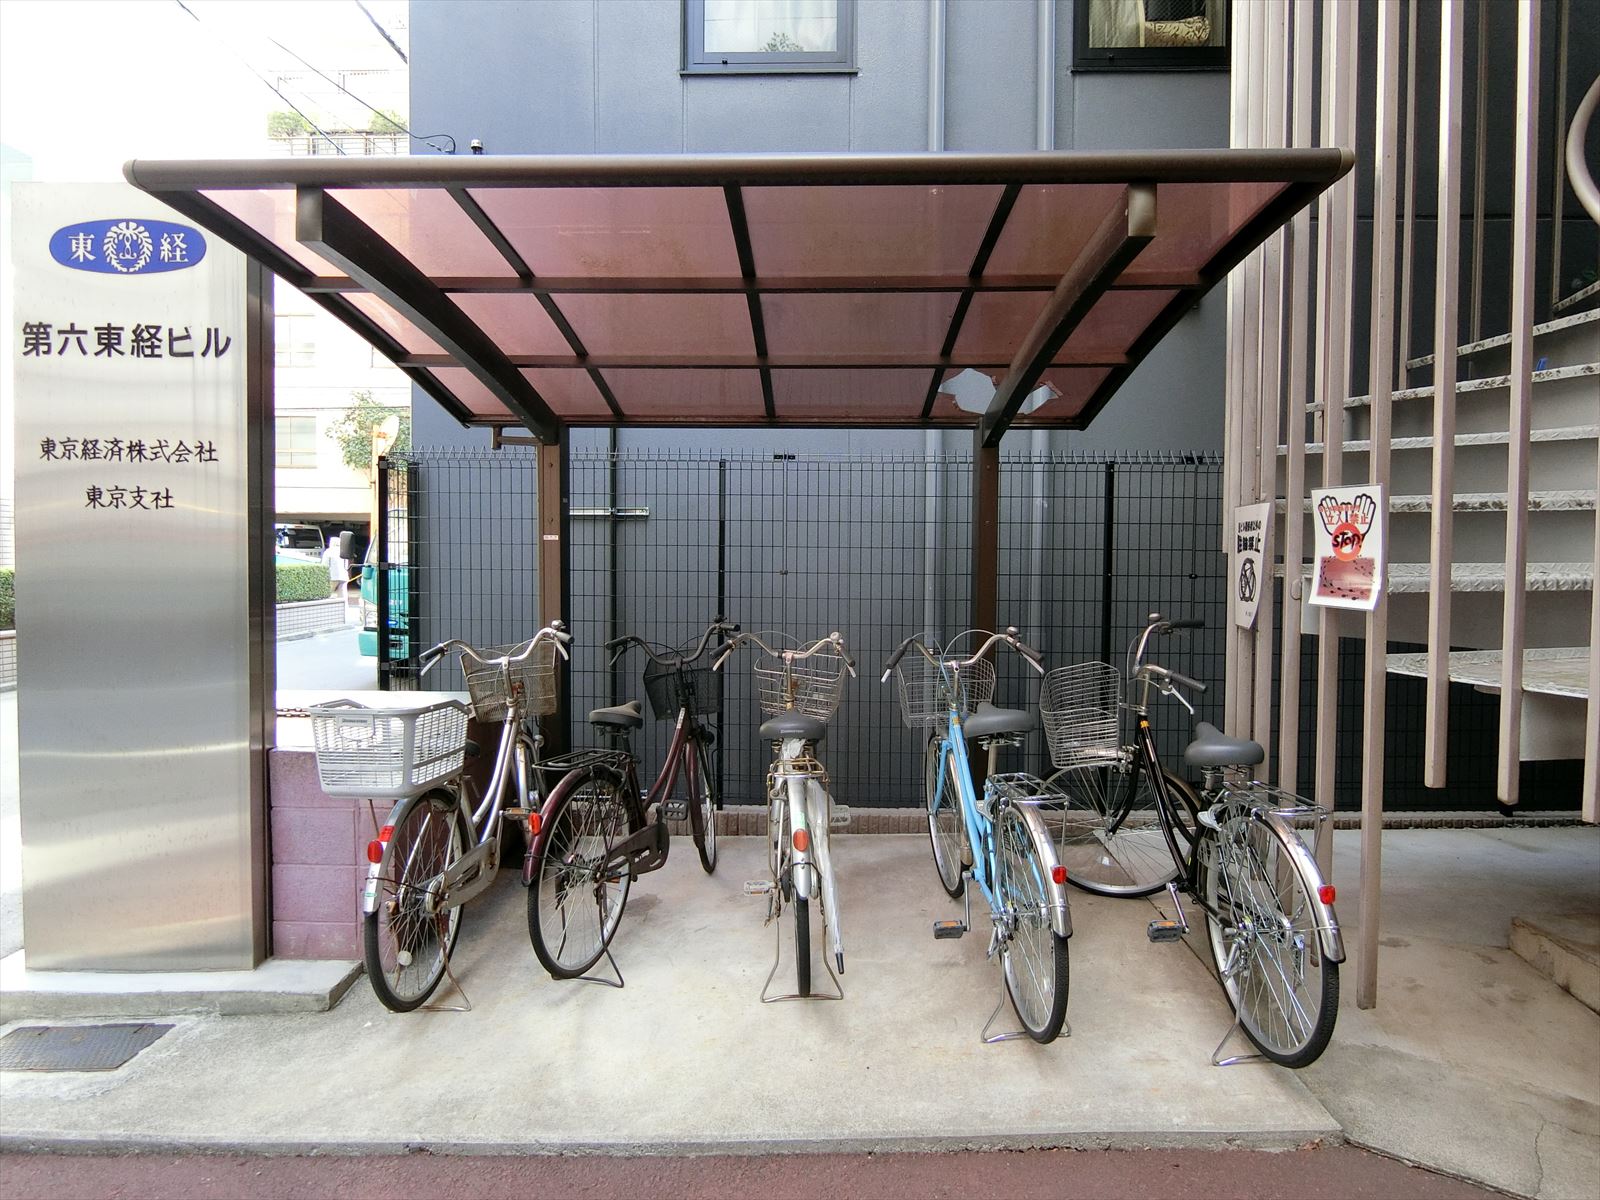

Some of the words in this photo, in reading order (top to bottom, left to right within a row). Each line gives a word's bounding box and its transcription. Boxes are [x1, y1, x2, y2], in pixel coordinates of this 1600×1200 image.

[68, 232, 97, 263] 東
[159, 232, 189, 263] 経
[22, 321, 232, 359] 第六東経ビル
[39, 436, 220, 463] 東京経済株式会社
[84, 484, 176, 510] 東京支社
